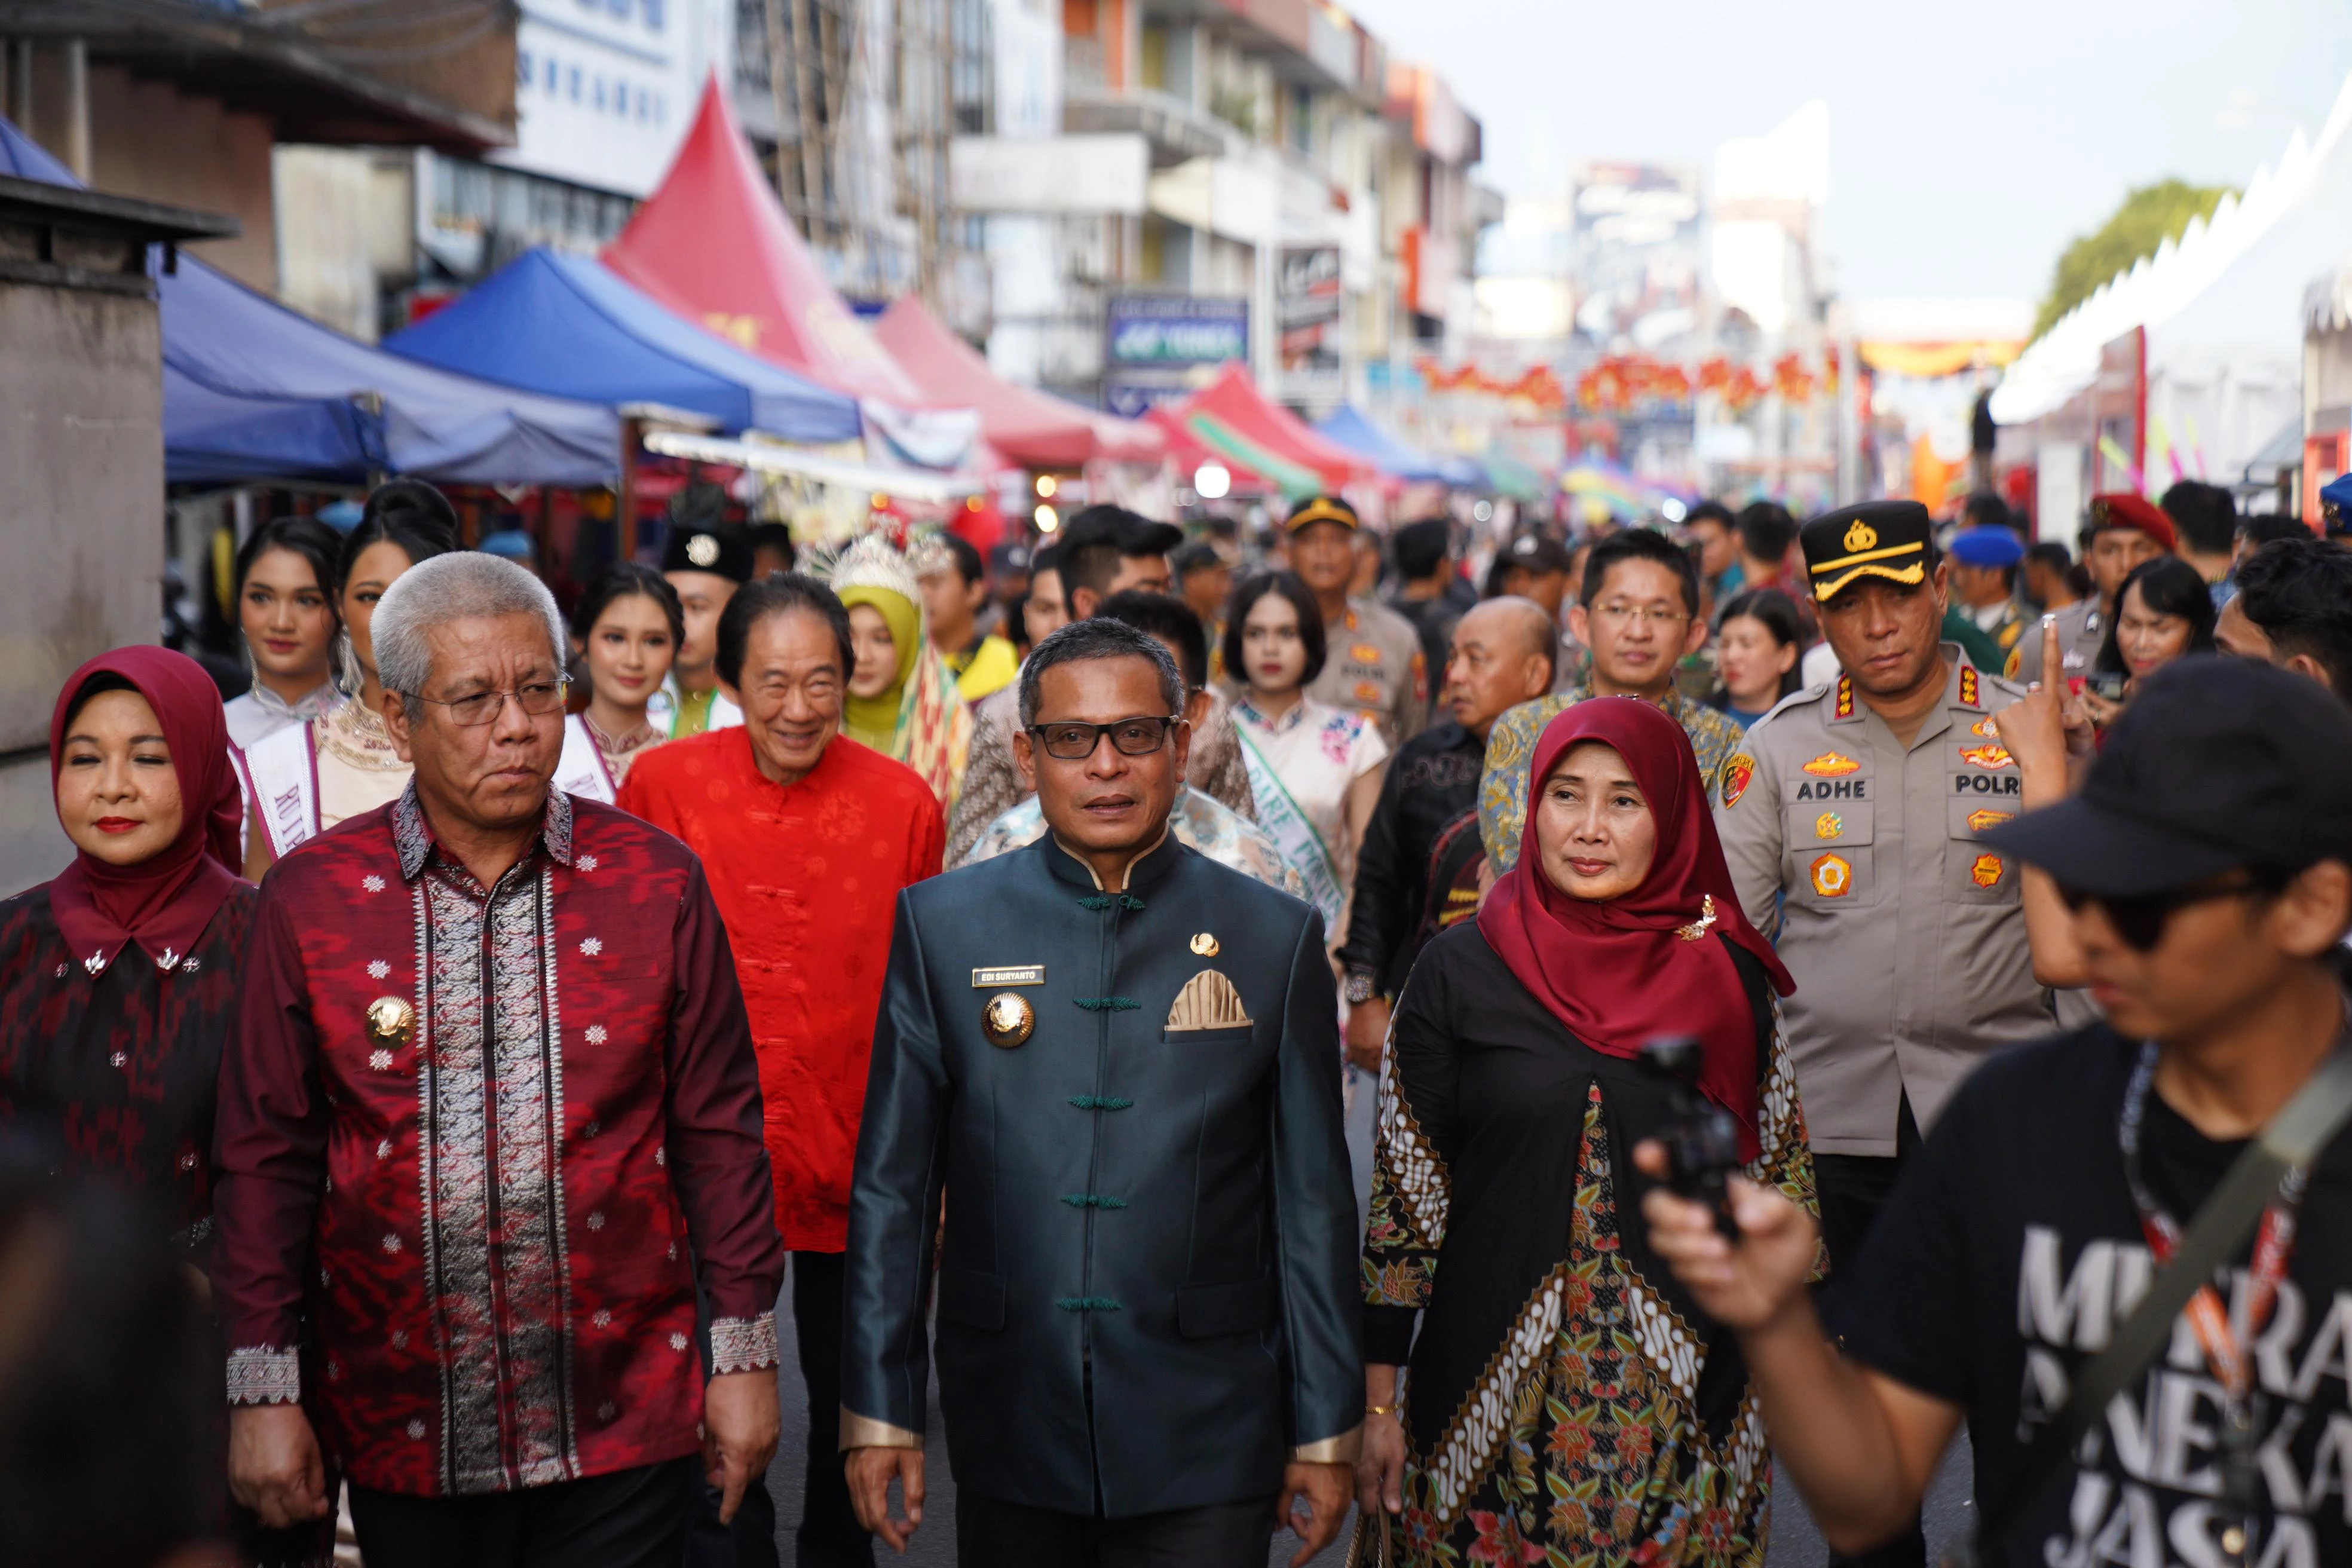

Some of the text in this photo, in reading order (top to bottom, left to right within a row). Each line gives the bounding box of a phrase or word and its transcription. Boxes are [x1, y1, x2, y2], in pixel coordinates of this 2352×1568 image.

[1796, 781, 1865, 801] ADHE
[1956, 775, 2022, 795] POLR
[981, 971, 1036, 981] EDI SURYANTO
